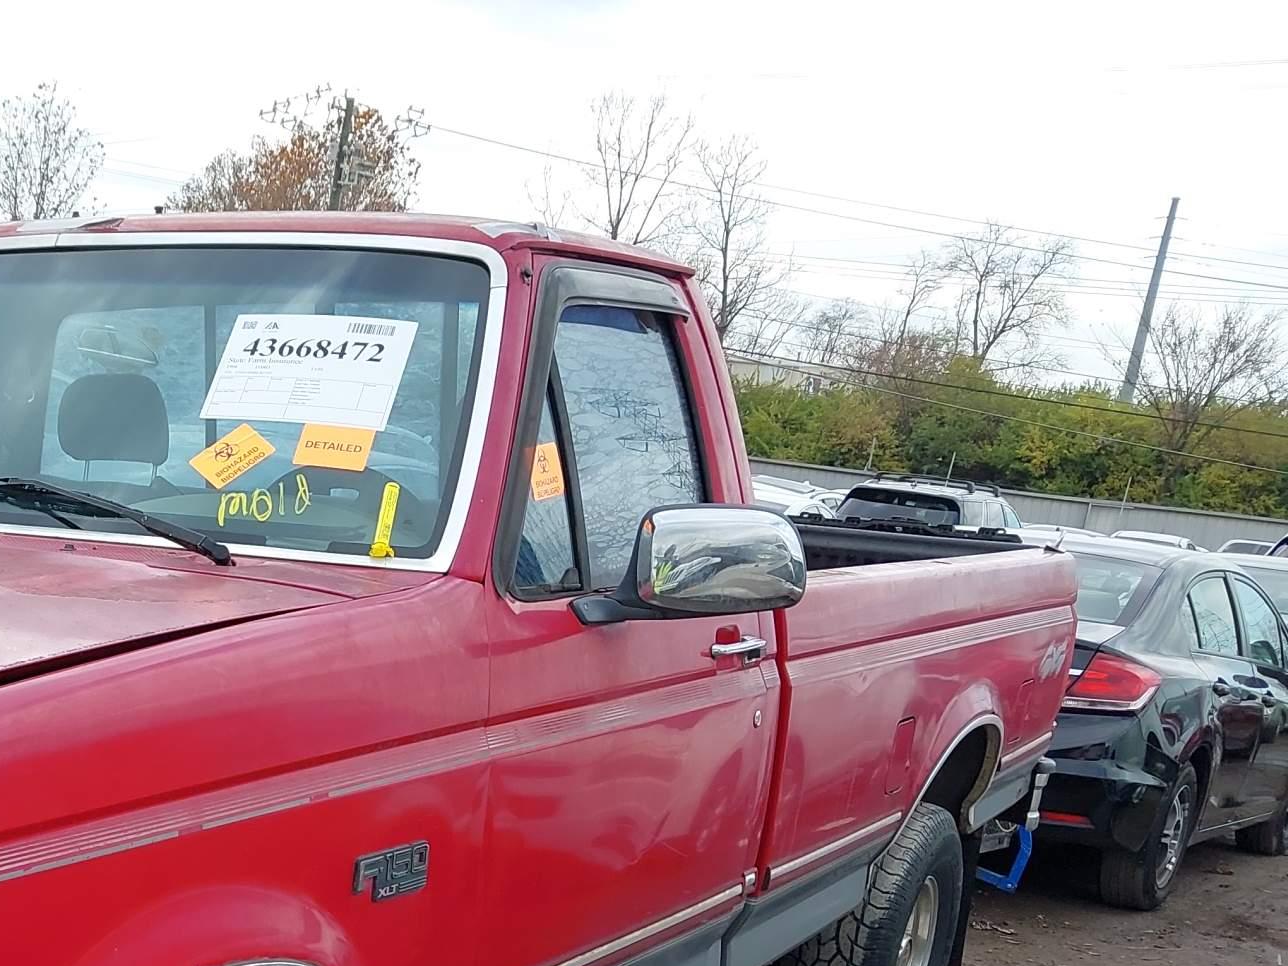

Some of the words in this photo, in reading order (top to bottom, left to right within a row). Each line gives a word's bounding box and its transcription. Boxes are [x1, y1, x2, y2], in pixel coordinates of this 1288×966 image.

[242, 337, 385, 362] 43668472
[305, 440, 362, 453] DETAILED
[215, 446, 259, 478] BIOHAZARD
[220, 451, 266, 484] BIOPELIGRO
[377, 883, 399, 899] XLT
